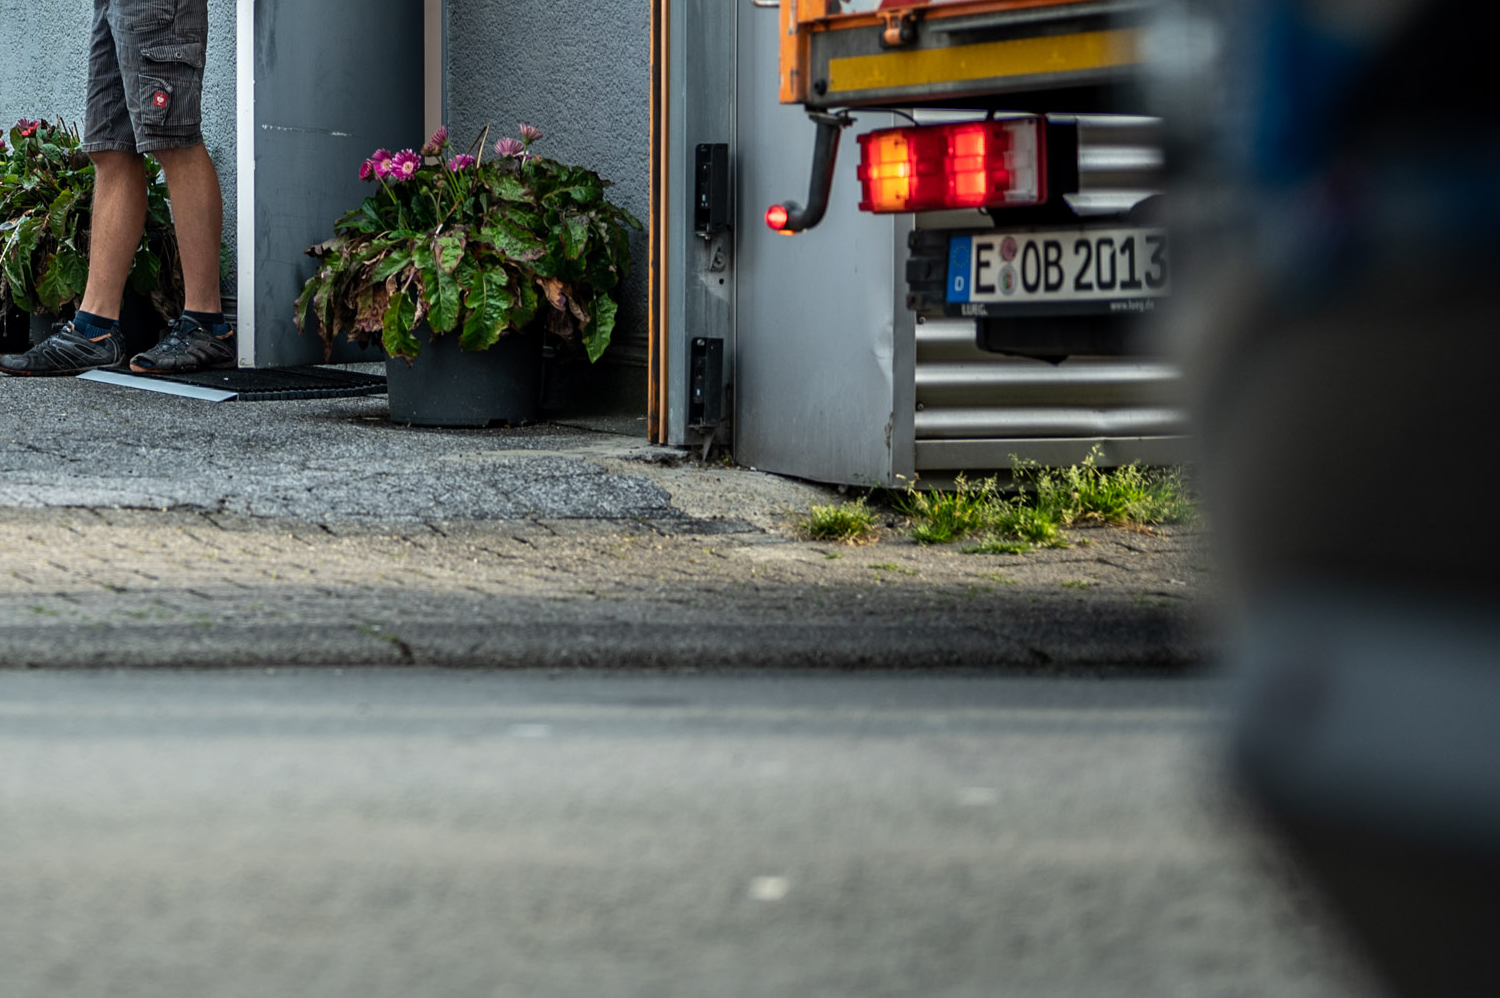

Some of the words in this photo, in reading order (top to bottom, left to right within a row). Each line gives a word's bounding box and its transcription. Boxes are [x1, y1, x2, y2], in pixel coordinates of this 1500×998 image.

[954, 276, 965, 291] D
[974, 243, 996, 294] E
[1021, 240, 1064, 294] OB
[1073, 234, 1168, 292] 2013
